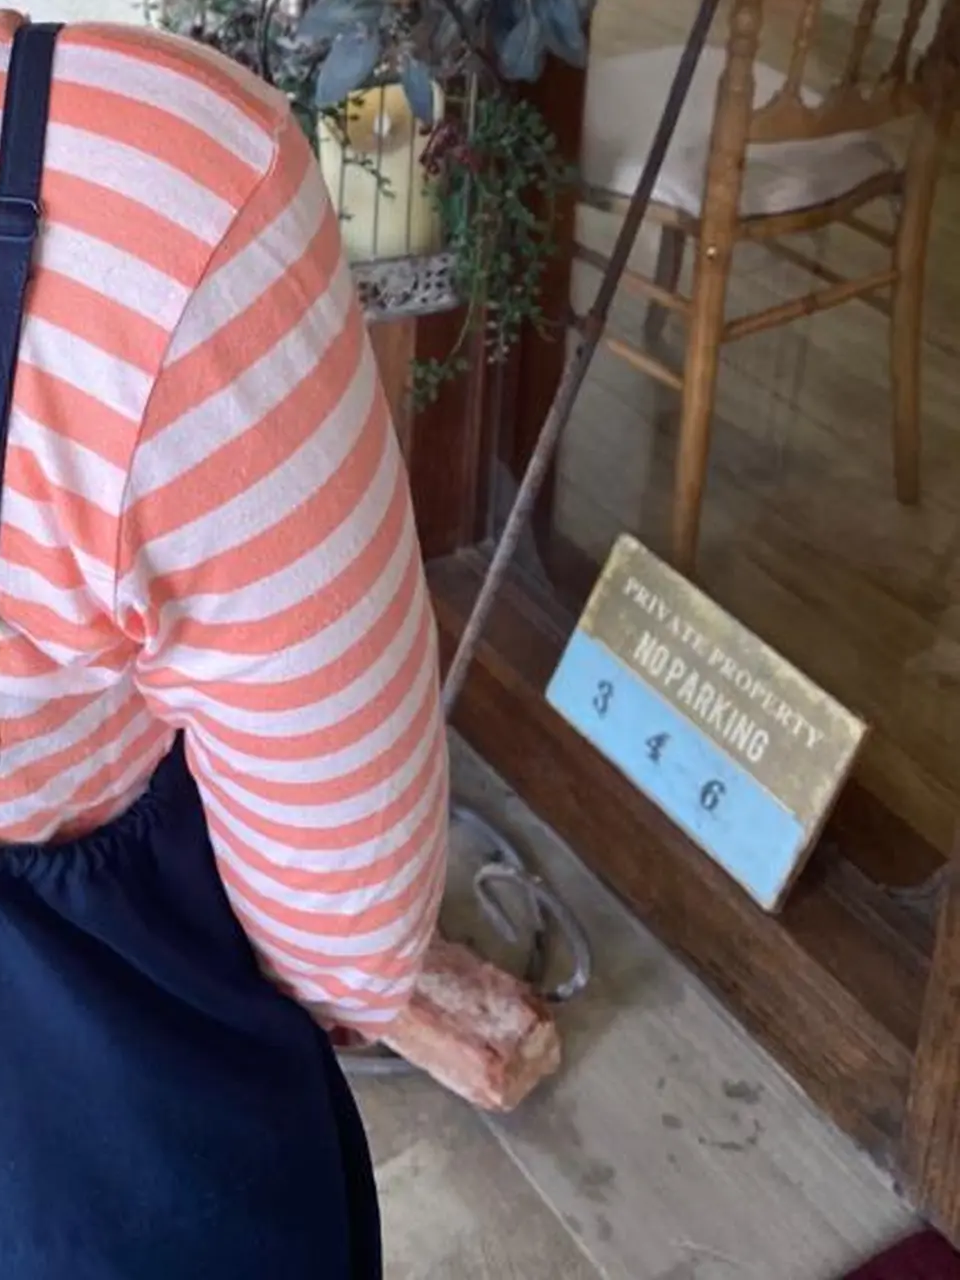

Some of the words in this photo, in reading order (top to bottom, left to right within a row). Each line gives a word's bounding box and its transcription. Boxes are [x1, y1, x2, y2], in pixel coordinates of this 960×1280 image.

[622, 576, 707, 658] PRIVATE
[708, 647, 826, 749] PROPERTY
[593, 680, 615, 717] 3
[645, 731, 673, 763] 4
[700, 779, 727, 812] 6
